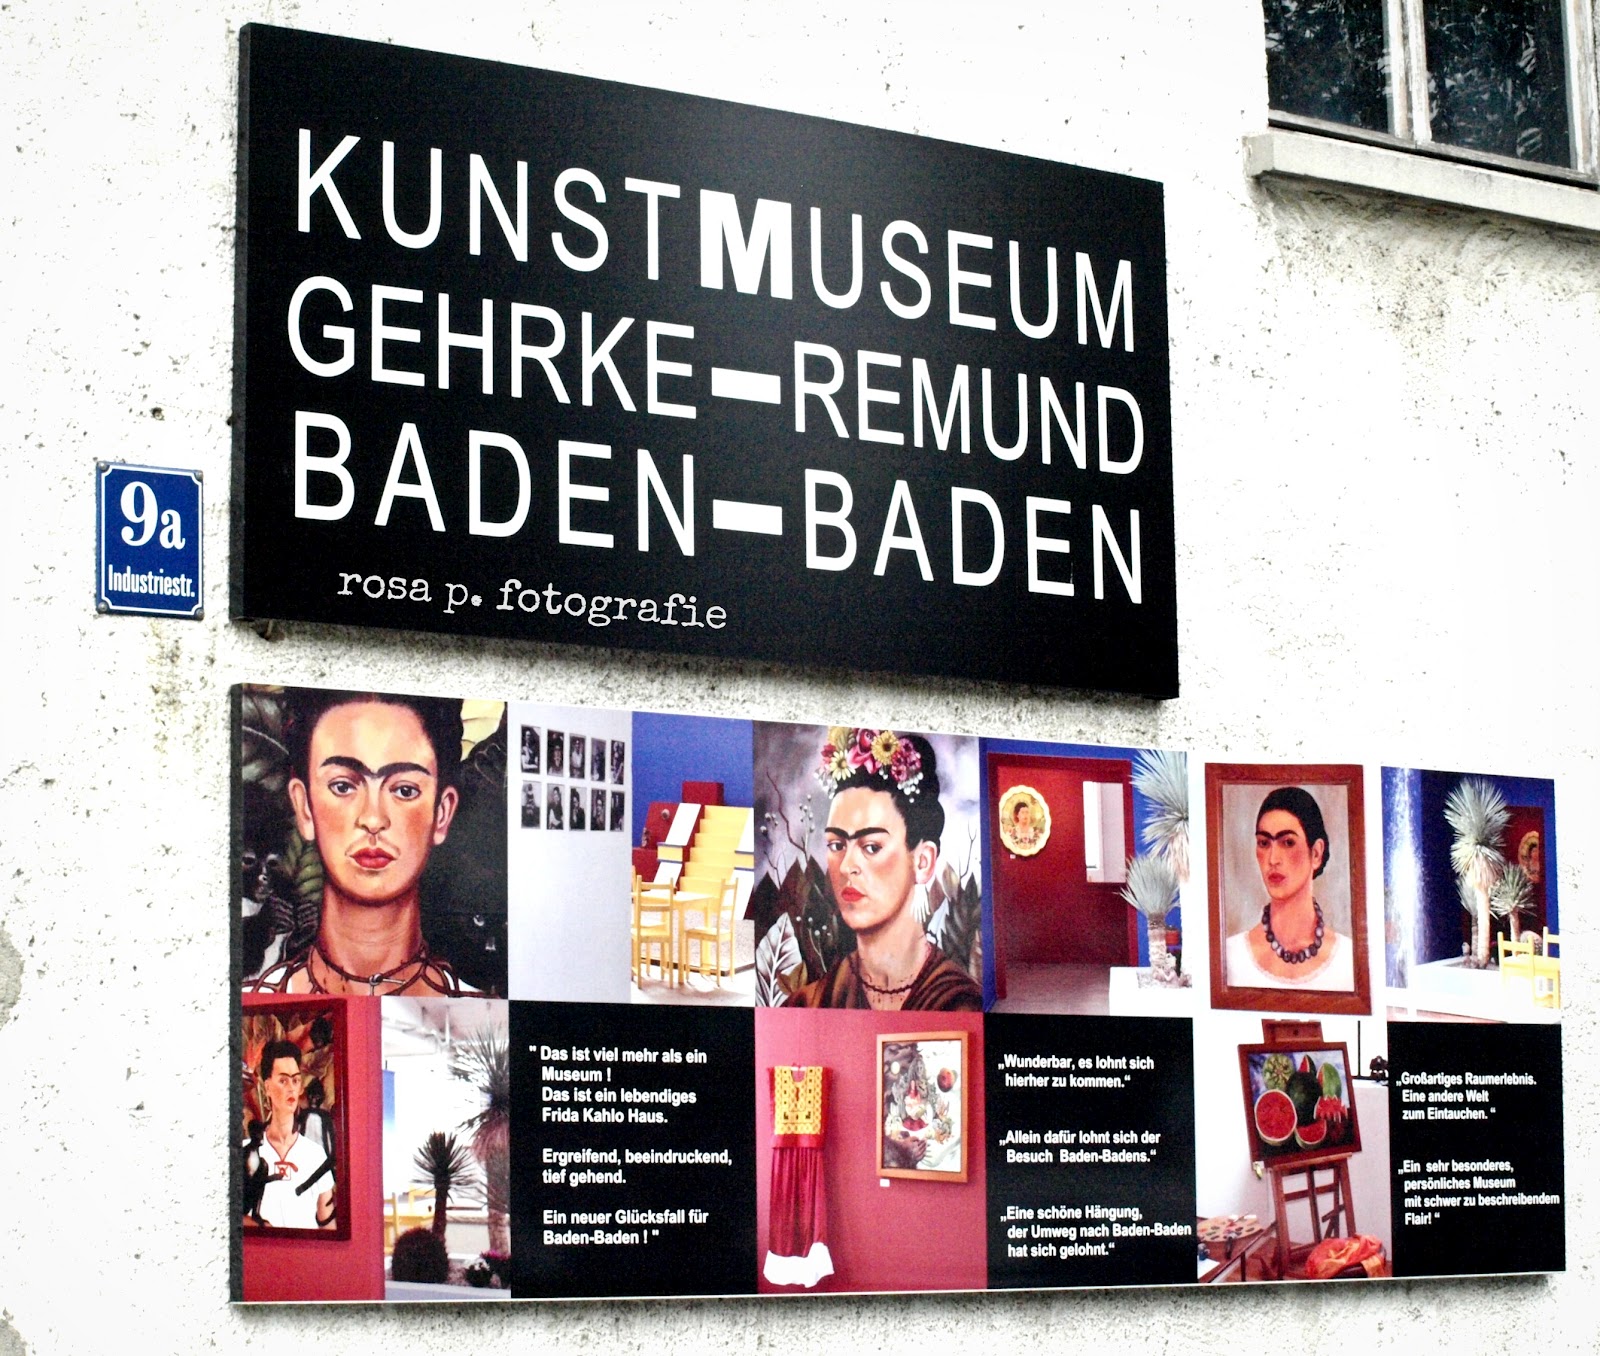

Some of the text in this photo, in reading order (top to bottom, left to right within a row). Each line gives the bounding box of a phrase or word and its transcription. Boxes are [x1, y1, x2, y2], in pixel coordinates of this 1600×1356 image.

[298, 129, 1134, 352] KUNSTMUSEUM
[288, 276, 1143, 474] GEHRKE-REMUND
[121, 481, 185, 549] 9a
[295, 411, 1141, 604] BADEN-BADEN
[109, 564, 195, 597] Industriestr.
[541, 1046, 568, 1061] Das
[572, 1046, 590, 1061] ist
[593, 1047, 618, 1061] viel
[622, 1048, 659, 1062] mehr
[662, 1049, 682, 1063] als
[686, 1049, 707, 1063] ein
[1078, 1058, 1092, 1069] es
[1096, 1055, 1127, 1069] lohnt
[1129, 1056, 1154, 1069] sich
[542, 1066, 602, 1081] Museum
[1005, 1073, 1049, 1087] hierher
[1052, 1077, 1066, 1087] zu
[1465, 1072, 1536, 1085] Raumerlebnis.
[542, 1087, 696, 1106] Das ist ein lebendiges
[1402, 1089, 1489, 1102] Eine andere Welt
[543, 1107, 668, 1123] Frida Kahlo Haus.
[1402, 1110, 1425, 1119] zum
[1428, 1107, 1488, 1119] Eintauchen.
[1044, 1130, 1076, 1143] dafür
[1079, 1131, 1110, 1143] lohnt
[1113, 1131, 1138, 1143] sich
[1141, 1131, 1161, 1143] der
[543, 1148, 732, 1166] Ergreifend, beeindruckend,
[1007, 1149, 1053, 1163] Besuch
[1426, 1160, 1449, 1172] sehr
[1452, 1159, 1513, 1172] besonderes,
[542, 1169, 626, 1187] tief gehend.
[1404, 1176, 1516, 1193] persönliches Museum
[1405, 1192, 1560, 1207] mit schwer zu beschreibendem
[543, 1209, 709, 1224] Ein neuer Glücksfall für
[1037, 1205, 1082, 1219] schöne
[1085, 1205, 1142, 1221] Hängung,
[1405, 1212, 1431, 1225] Flair!
[544, 1230, 639, 1245] Baden-Baden
[1007, 1222, 1191, 1240] der Umweg nach Baden-Baden
[1008, 1244, 1028, 1257] hat
[1031, 1243, 1056, 1257] sich
